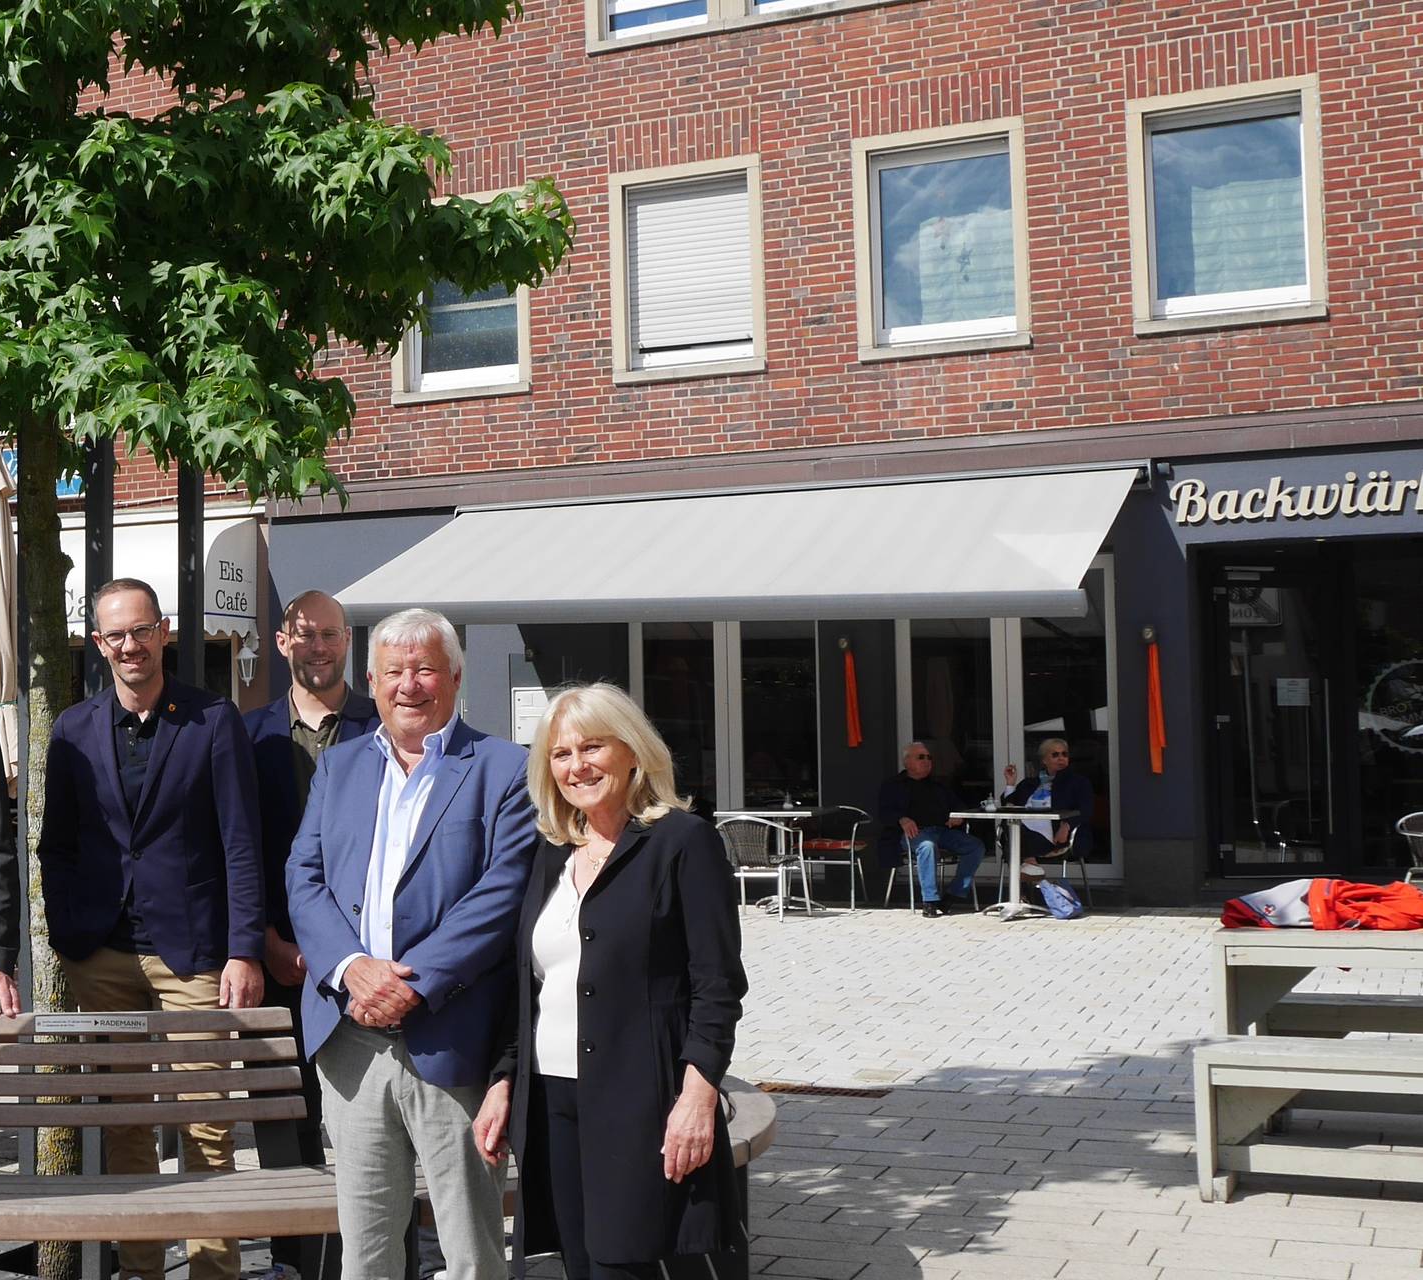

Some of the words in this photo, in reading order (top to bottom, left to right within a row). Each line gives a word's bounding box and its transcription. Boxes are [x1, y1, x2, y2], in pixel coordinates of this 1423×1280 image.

[1169, 470, 1423, 523] Backwiär
[219, 561, 243, 583] Eis
[215, 589, 248, 612] Café
